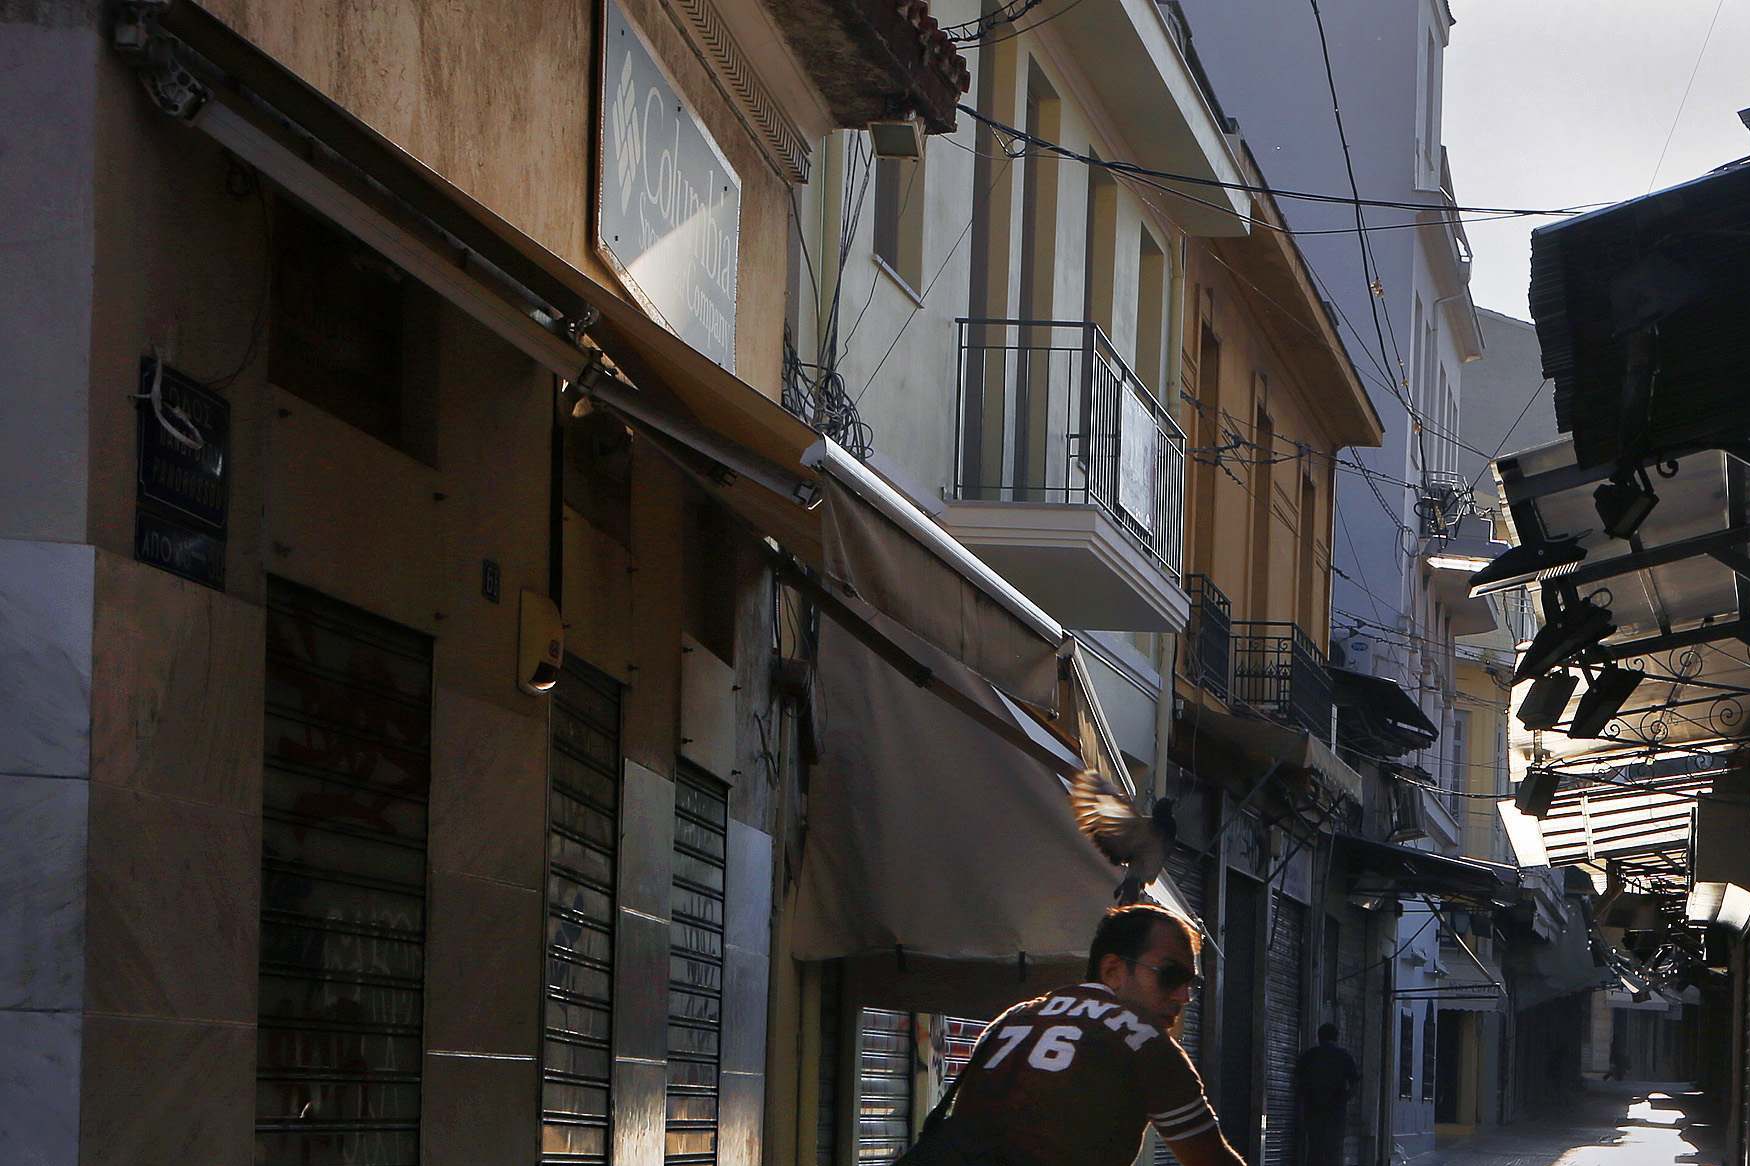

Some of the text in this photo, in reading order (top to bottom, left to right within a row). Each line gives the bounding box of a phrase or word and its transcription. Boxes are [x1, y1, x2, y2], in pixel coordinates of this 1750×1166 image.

[643, 86, 733, 301] Columbia
[686, 260, 730, 358] Company
[983, 1025, 1083, 1072] 76
